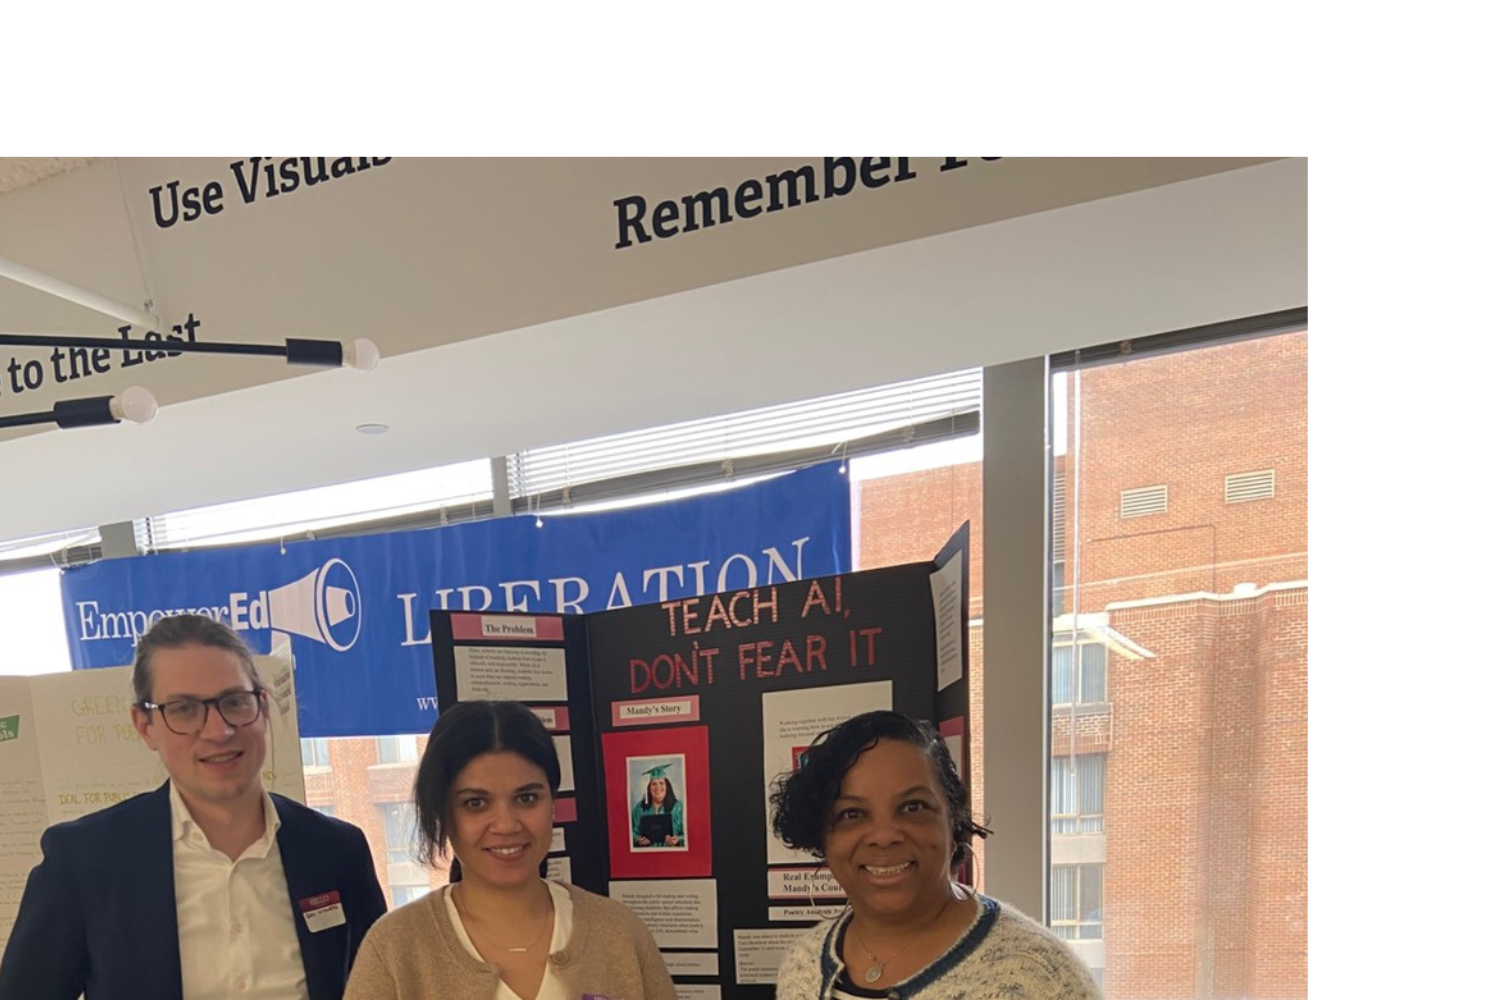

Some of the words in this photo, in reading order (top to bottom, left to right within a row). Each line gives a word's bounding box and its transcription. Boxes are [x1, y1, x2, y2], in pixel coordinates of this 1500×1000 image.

[149, 180, 224, 228] Use
[613, 157, 918, 250] Remember
[7, 357, 44, 394] to
[50, 345, 111, 384] the
[485, 624, 500, 633] The
[502, 624, 534, 634] Problem
[661, 587, 779, 637] TEACH
[800, 576, 851, 619] AI,
[629, 640, 720, 694] DON'T
[738, 634, 828, 681] FEAR
[849, 628, 884, 668] IT
[660, 702, 682, 714] Story
[783, 873, 802, 882] Real
